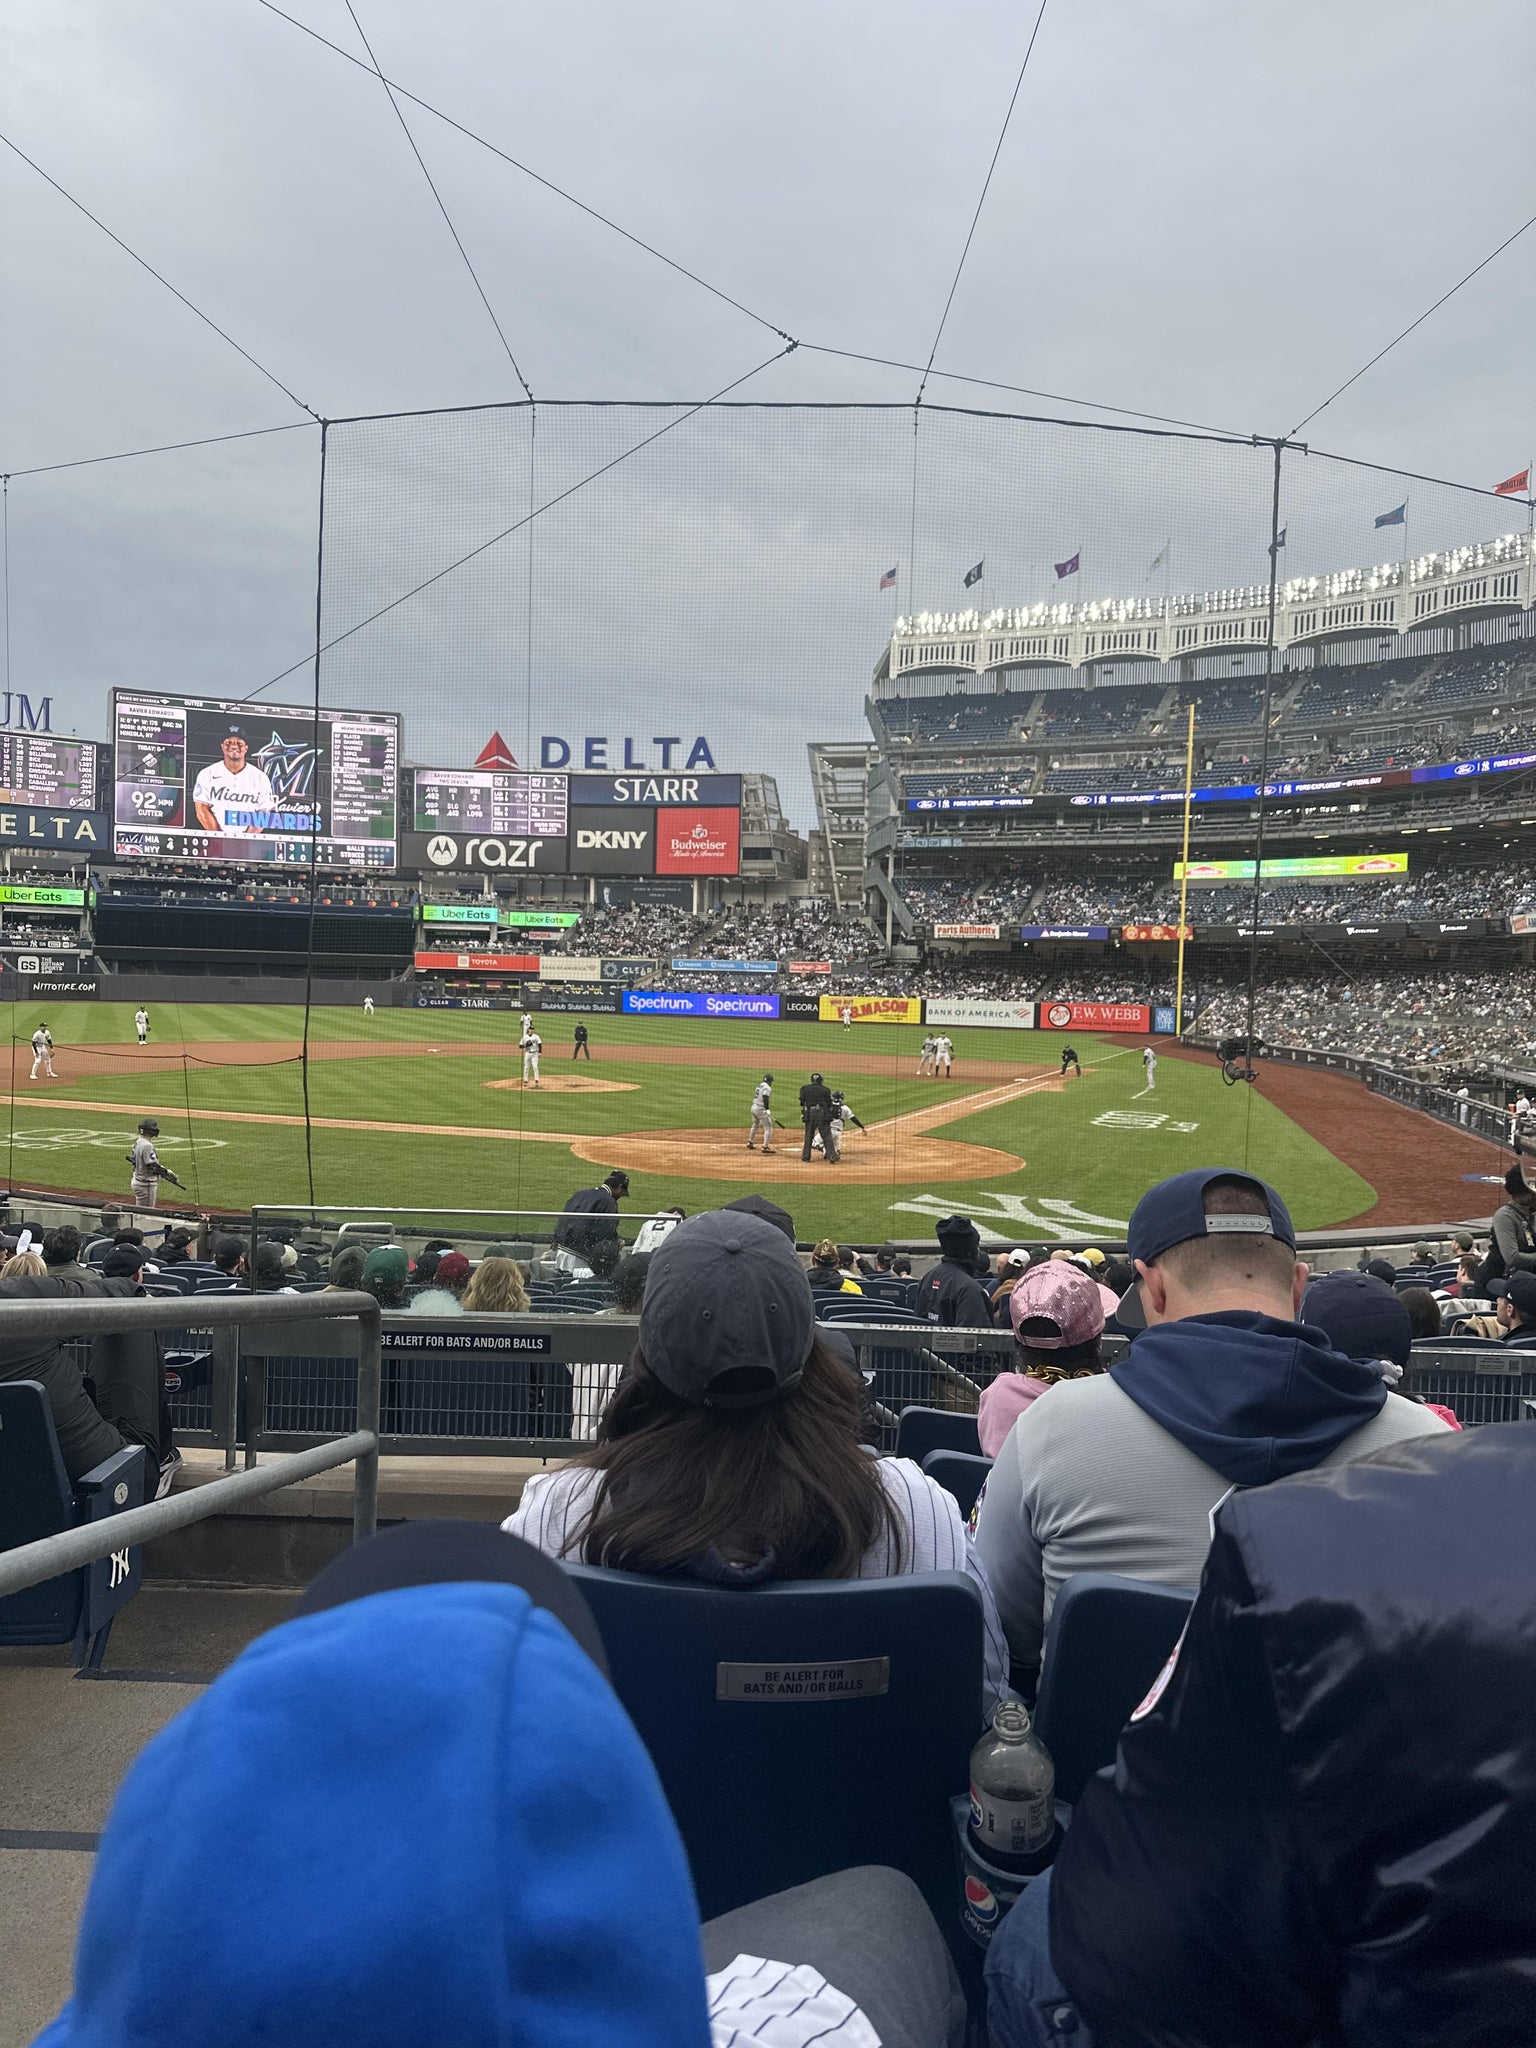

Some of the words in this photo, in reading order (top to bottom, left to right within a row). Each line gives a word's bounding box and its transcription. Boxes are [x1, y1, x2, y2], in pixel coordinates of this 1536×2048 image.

[541, 736, 716, 770] DELTA
[210, 786, 260, 804] Miami
[613, 778, 700, 802] STARR
[69, 798, 91, 807] 6:20
[132, 790, 156, 809] 92
[270, 793, 312, 812] Xavier
[228, 810, 322, 831] EDWARDS
[577, 830, 648, 850] DKNY
[670, 839, 726, 850] Budweiser
[465, 838, 543, 868] razr
[4, 890, 32, 900] Uber
[34, 892, 62, 902] Eats
[442, 910, 466, 918] Uber
[467, 910, 491, 920] Eats
[938, 926, 958, 934] Parts
[959, 926, 996, 936] Authority
[21, 961, 36, 970] GS
[33, 982, 96, 992] NITTOTIRE.COM
[462, 1000, 490, 1008] STARR
[542, 1002, 566, 1010] StubHub
[592, 1004, 616, 1012] StubHub
[629, 996, 688, 1010] Spectrum
[706, 998, 768, 1013] Spectrum
[787, 1003, 818, 1012] LEGORA
[837, 1000, 908, 1019] WB.MASON
[928, 1008, 952, 1016] BANK
[968, 1010, 1010, 1018] AMERICA
[1073, 1007, 1097, 1018] F.W.
[1101, 1008, 1141, 1020] WEBB
[381, 1335, 392, 1346] BE
[394, 1336, 424, 1347] ALERT
[426, 1336, 444, 1347] FOR
[446, 1336, 472, 1348] BATS
[473, 1336, 512, 1349] AND/OR
[513, 1338, 544, 1350] BALLS
[765, 1672, 780, 1682] BE
[784, 1670, 819, 1681] ALERT
[823, 1670, 844, 1680] FOR
[744, 1684, 774, 1694] BATS
[778, 1682, 826, 1694] AND/OR
[829, 1680, 864, 1692] BALLS
